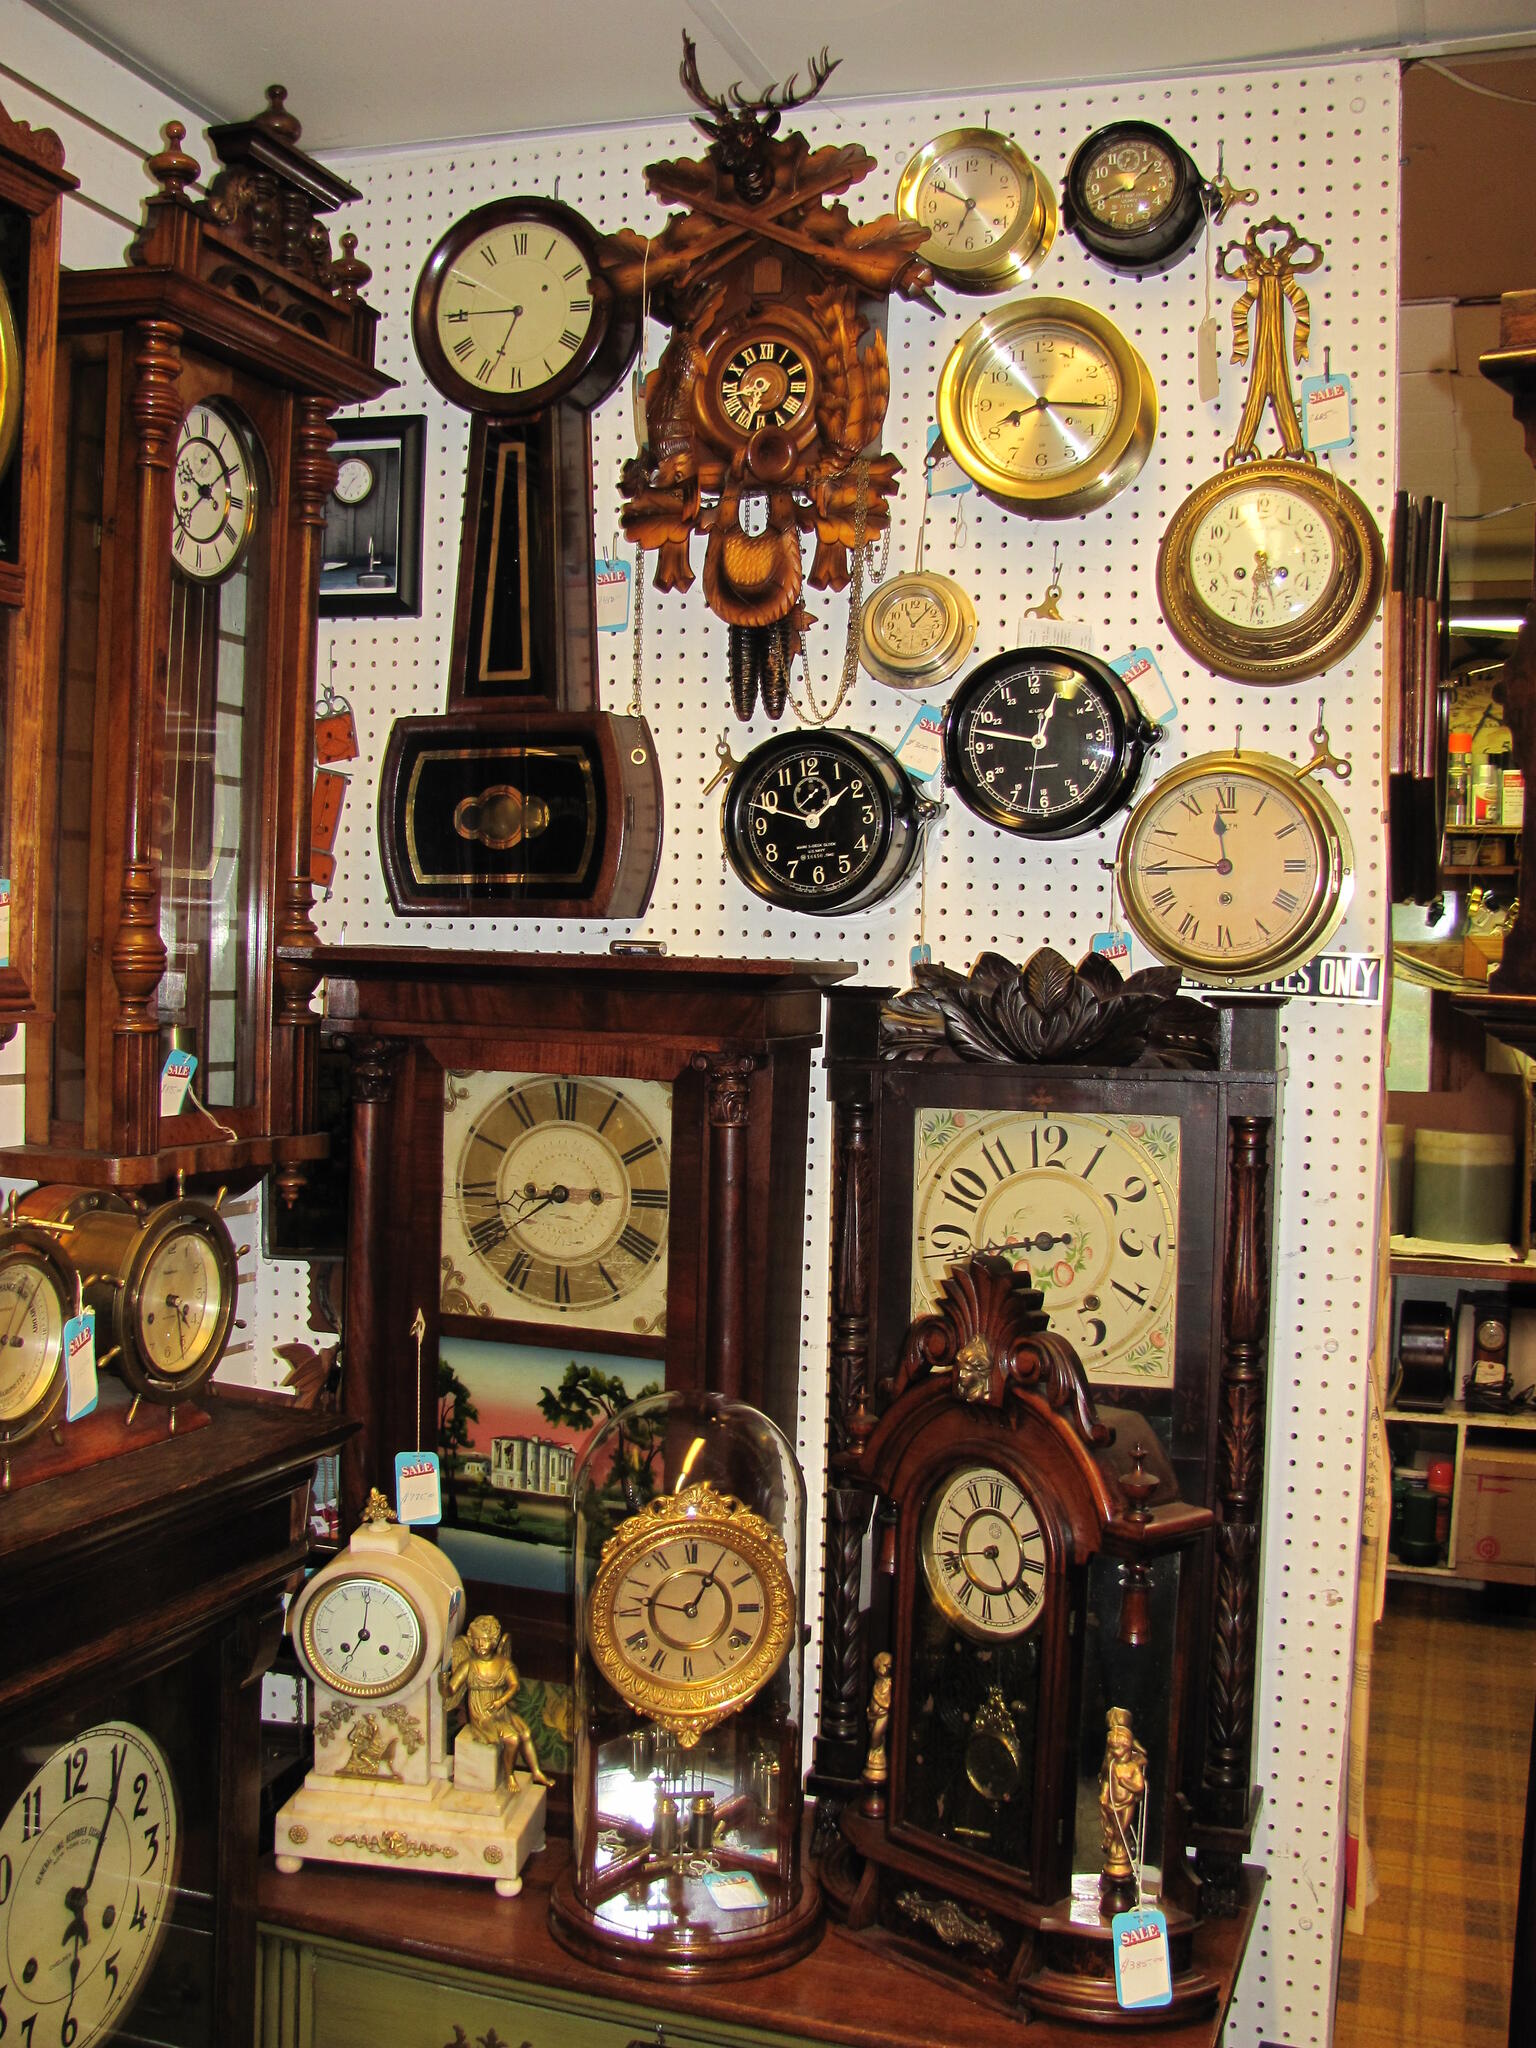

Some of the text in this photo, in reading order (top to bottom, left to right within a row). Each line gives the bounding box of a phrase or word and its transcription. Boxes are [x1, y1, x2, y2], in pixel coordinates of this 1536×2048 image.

[1108, 153, 1117, 165] 11
[1143, 151, 1147, 161] 1
[949, 166, 958, 178] 11
[966, 160, 978, 173] 12
[990, 164, 994, 175] 1
[1096, 167, 1108, 179] 10
[1154, 161, 1162, 172] 2
[1000, 176, 1008, 189] 2
[1159, 176, 1166, 187] 3
[1091, 184, 1099, 195] 9
[1006, 197, 1015, 209] 3
[1097, 199, 1104, 210] 8
[1152, 195, 1160, 205] 4
[929, 201, 937, 213] 9
[1000, 217, 1009, 227] 4
[1110, 211, 1119, 222] 7
[1126, 213, 1134, 224] 6
[933, 219, 941, 231] 8
[945, 234, 954, 249] 7
[965, 237, 973, 249] 6
[985, 231, 993, 243] 5
[1035, 342, 1054, 353] 12
[1011, 350, 1025, 362] 11
[991, 371, 1008, 383] 10
[1086, 366, 1098, 378] 2
[1309, 384, 1344, 404] SALE
[980, 400, 992, 411] 9
[988, 428, 1000, 440] 8
[1084, 424, 1095, 436] 4
[1008, 447, 1019, 460] 7
[1035, 454, 1048, 466] 6
[1229, 506, 1239, 520] 11
[1287, 506, 1291, 520] 1
[1210, 526, 1223, 540] 10
[1304, 524, 1313, 538] 2
[1203, 552, 1212, 565] 9
[1311, 549, 1319, 564] 3
[597, 571, 626, 584] SALE
[1301, 576, 1309, 591] 4
[1210, 579, 1218, 592] 8
[1230, 597, 1236, 612] 7
[1283, 596, 1292, 609] 5
[1256, 604, 1264, 617] 6
[1028, 676, 1040, 687] 12
[1001, 688, 1010, 699] 11
[1085, 700, 1094, 711] 2
[980, 711, 993, 723] 10
[920, 717, 944, 734] SAL
[1096, 730, 1104, 741] 3
[976, 743, 984, 754] 9
[800, 758, 819, 776] 12
[834, 763, 840, 779] 1
[1089, 761, 1098, 771] 4
[779, 769, 792, 786] 11
[986, 771, 994, 782] 8
[852, 780, 863, 798] 2
[1070, 785, 1078, 796] 5
[761, 791, 778, 813] 10
[1010, 791, 1019, 802] 7
[1040, 797, 1048, 807] 6
[863, 806, 874, 824] 3
[756, 818, 767, 835] 9
[854, 834, 868, 851] 4
[766, 844, 778, 862] 8
[787, 860, 798, 878] 7
[839, 855, 850, 873] 5
[813, 866, 824, 884] 6
[1320, 958, 1378, 998] ONLY
[168, 1065, 190, 1076] SALE
[1026, 1124, 1072, 1170] 12
[981, 1136, 1019, 1181] 11
[1078, 1144, 1107, 1183] 1
[941, 1167, 987, 1214] 10
[1104, 1176, 1147, 1216] 2
[931, 1224, 973, 1251] 9
[1119, 1228, 1162, 1259] 3
[1109, 1279, 1149, 1313] 4
[1077, 1306, 1106, 1346] 5
[69, 1327, 92, 1356] SALE
[402, 1462, 434, 1478] SALE
[63, 1747, 88, 1803] 12
[133, 1773, 148, 1820] 2
[21, 1786, 42, 1843] 11
[141, 1823, 160, 1876] 3
[129, 1884, 148, 1931] 4
[1120, 1924, 1160, 1946] SALE
[103, 1948, 121, 2009] 5
